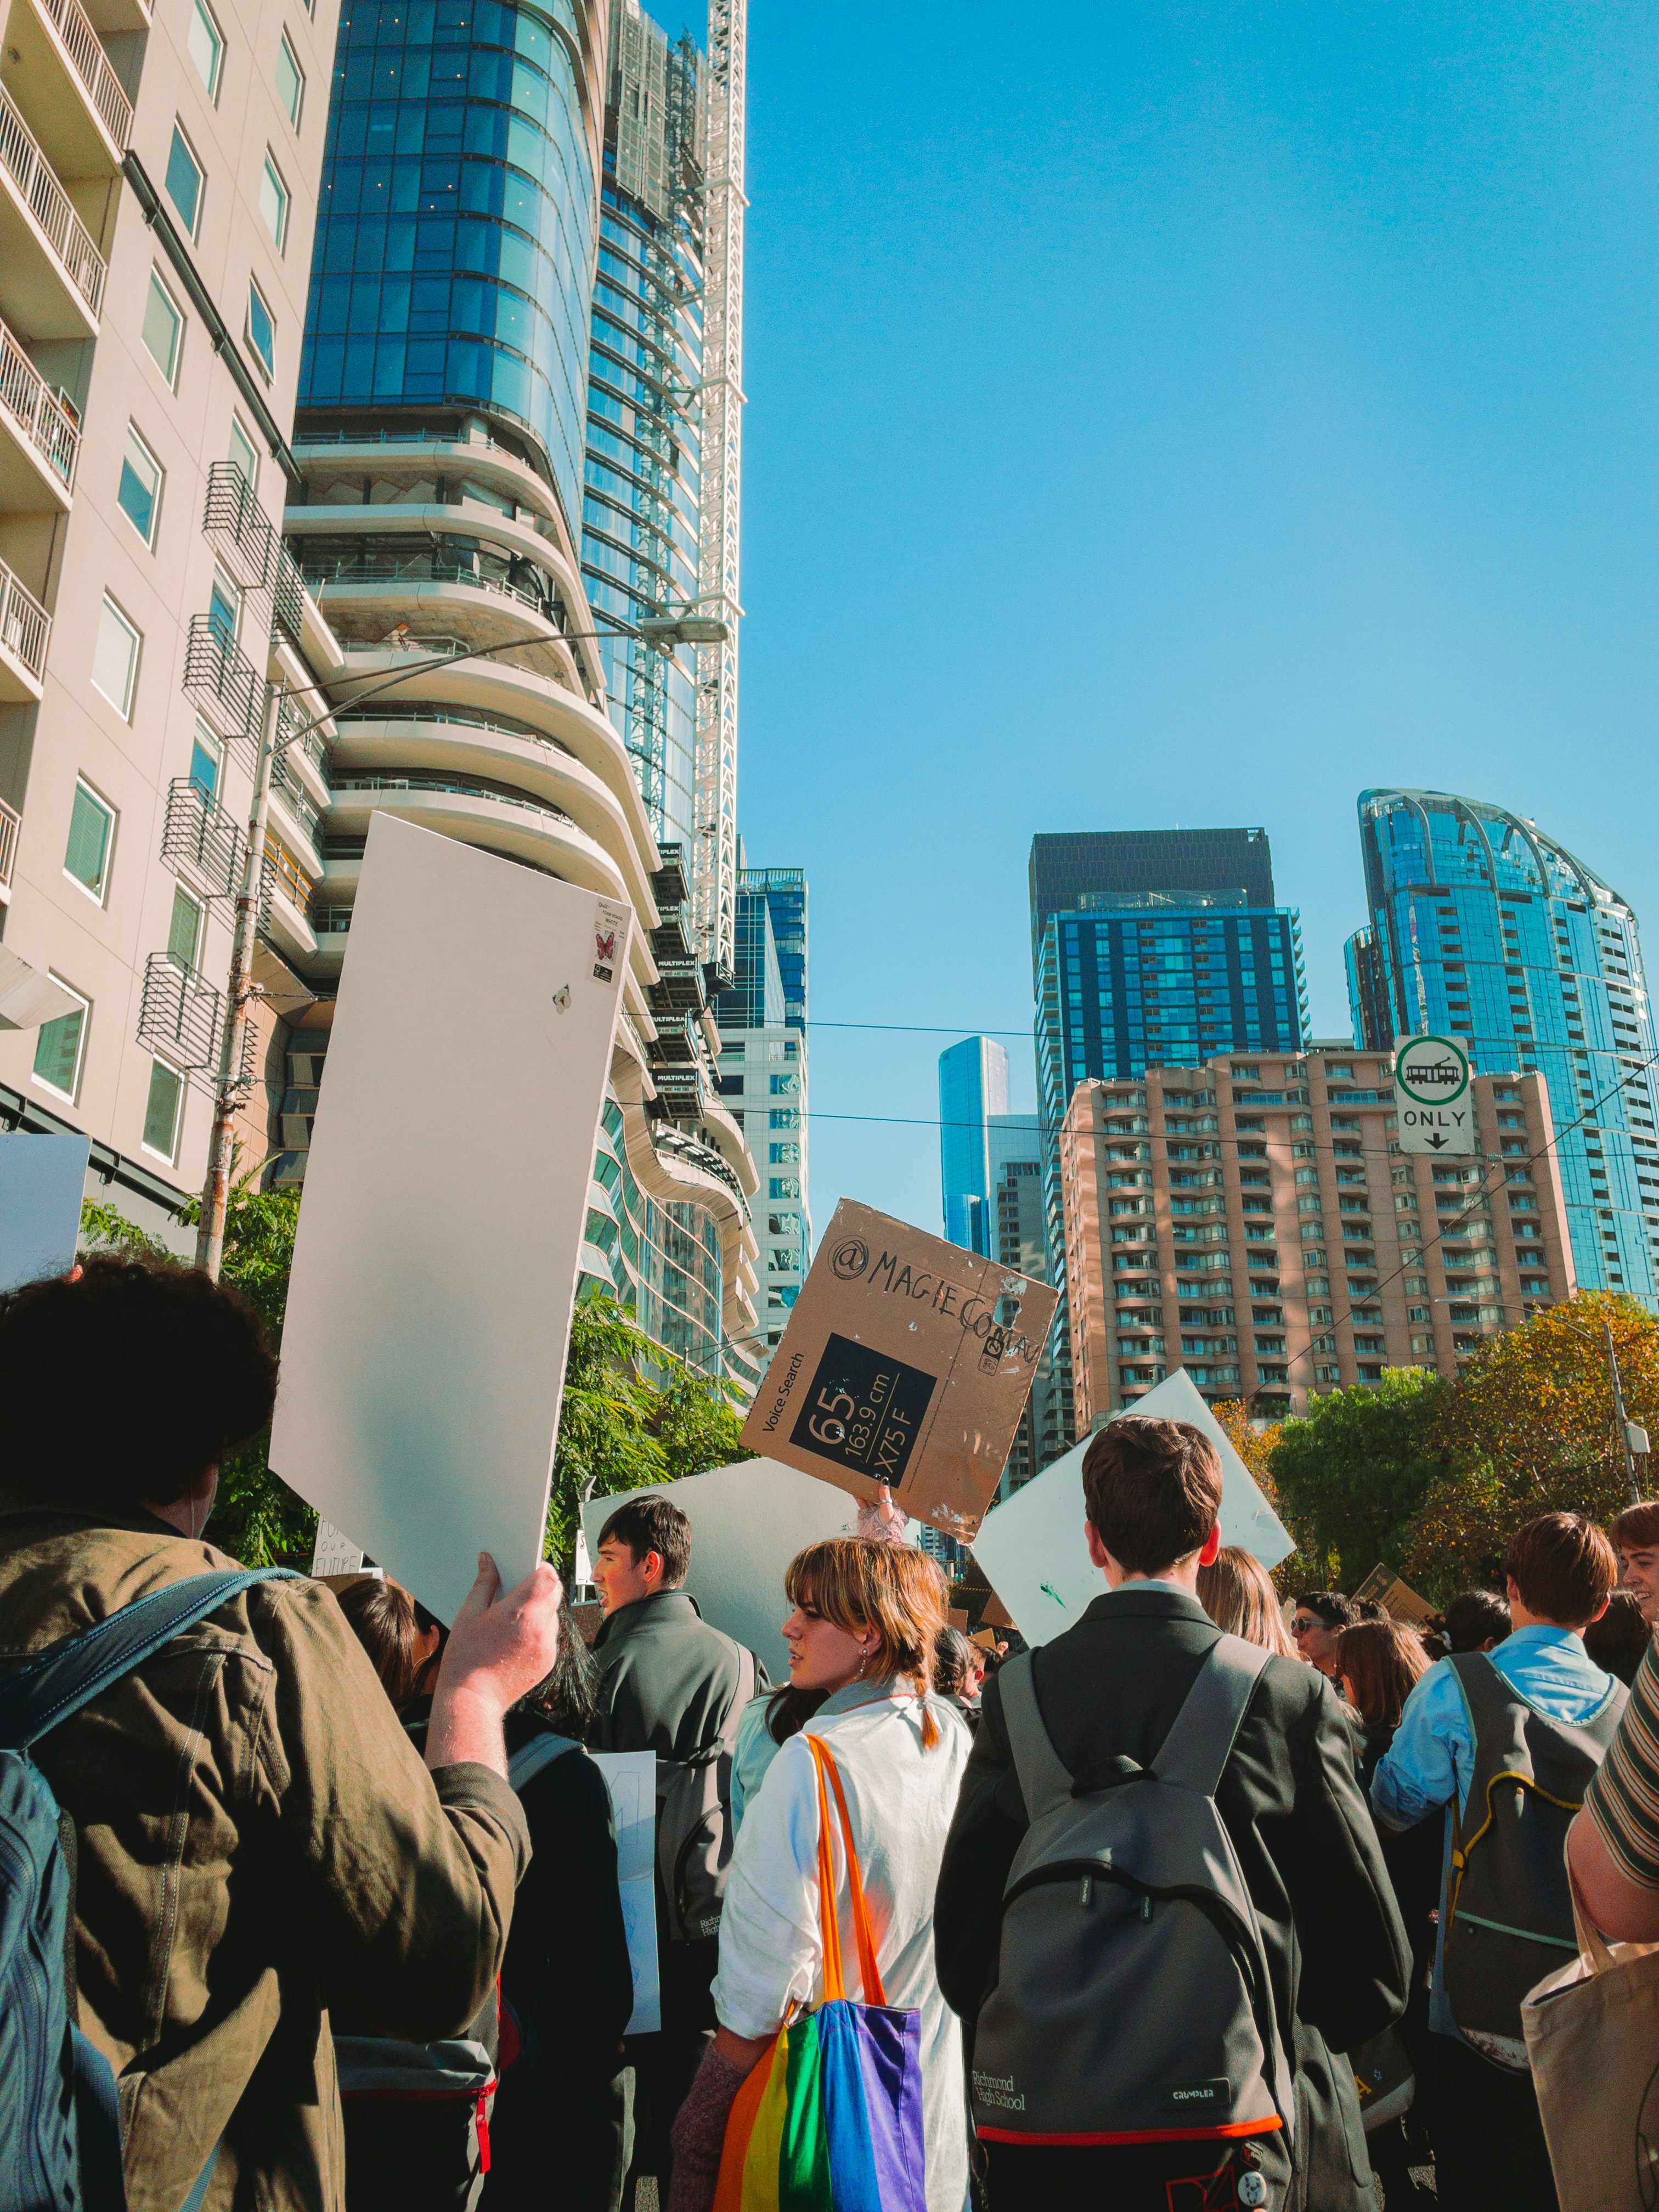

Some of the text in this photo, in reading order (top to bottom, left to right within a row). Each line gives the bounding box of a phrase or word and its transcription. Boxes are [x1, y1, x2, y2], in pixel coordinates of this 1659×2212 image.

[605, 917, 618, 927] WHITE
[1404, 1110, 1465, 1127] ONLY
[762, 1352, 805, 1434] Voice Search
[809, 1387, 855, 1444] 65
[845, 1374, 890, 1457] 163.9 cm
[873, 1408, 911, 1474] X75 F
[321, 1541, 345, 1552] OUR
[972, 2070, 1014, 2092] Richmond
[975, 2086, 1026, 2111] High School
